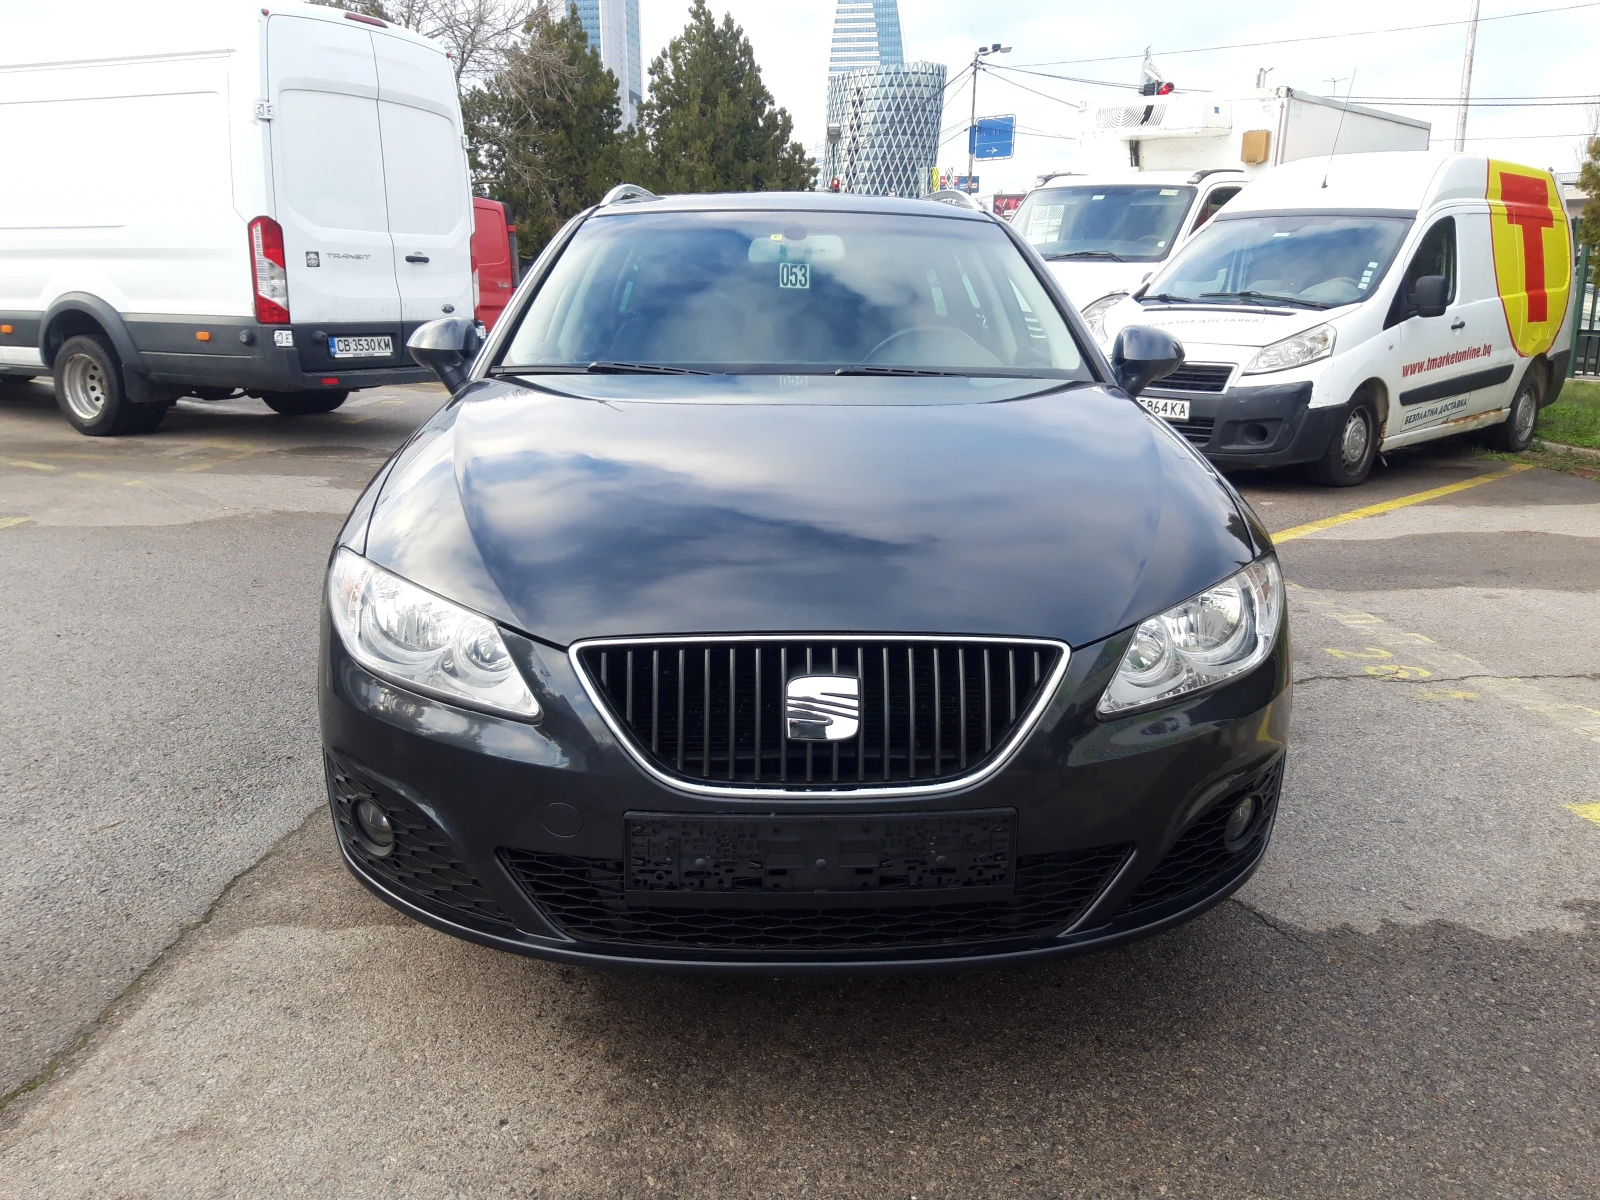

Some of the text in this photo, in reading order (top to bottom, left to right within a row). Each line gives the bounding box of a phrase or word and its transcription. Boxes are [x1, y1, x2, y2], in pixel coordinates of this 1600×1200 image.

[326, 252, 371, 260] TRANSIT
[781, 263, 808, 288] 053
[1402, 343, 1492, 378] www.tmarketonline.bg
[1404, 398, 1468, 425] БЕЗПЛАТНА ДОСТАВКА
